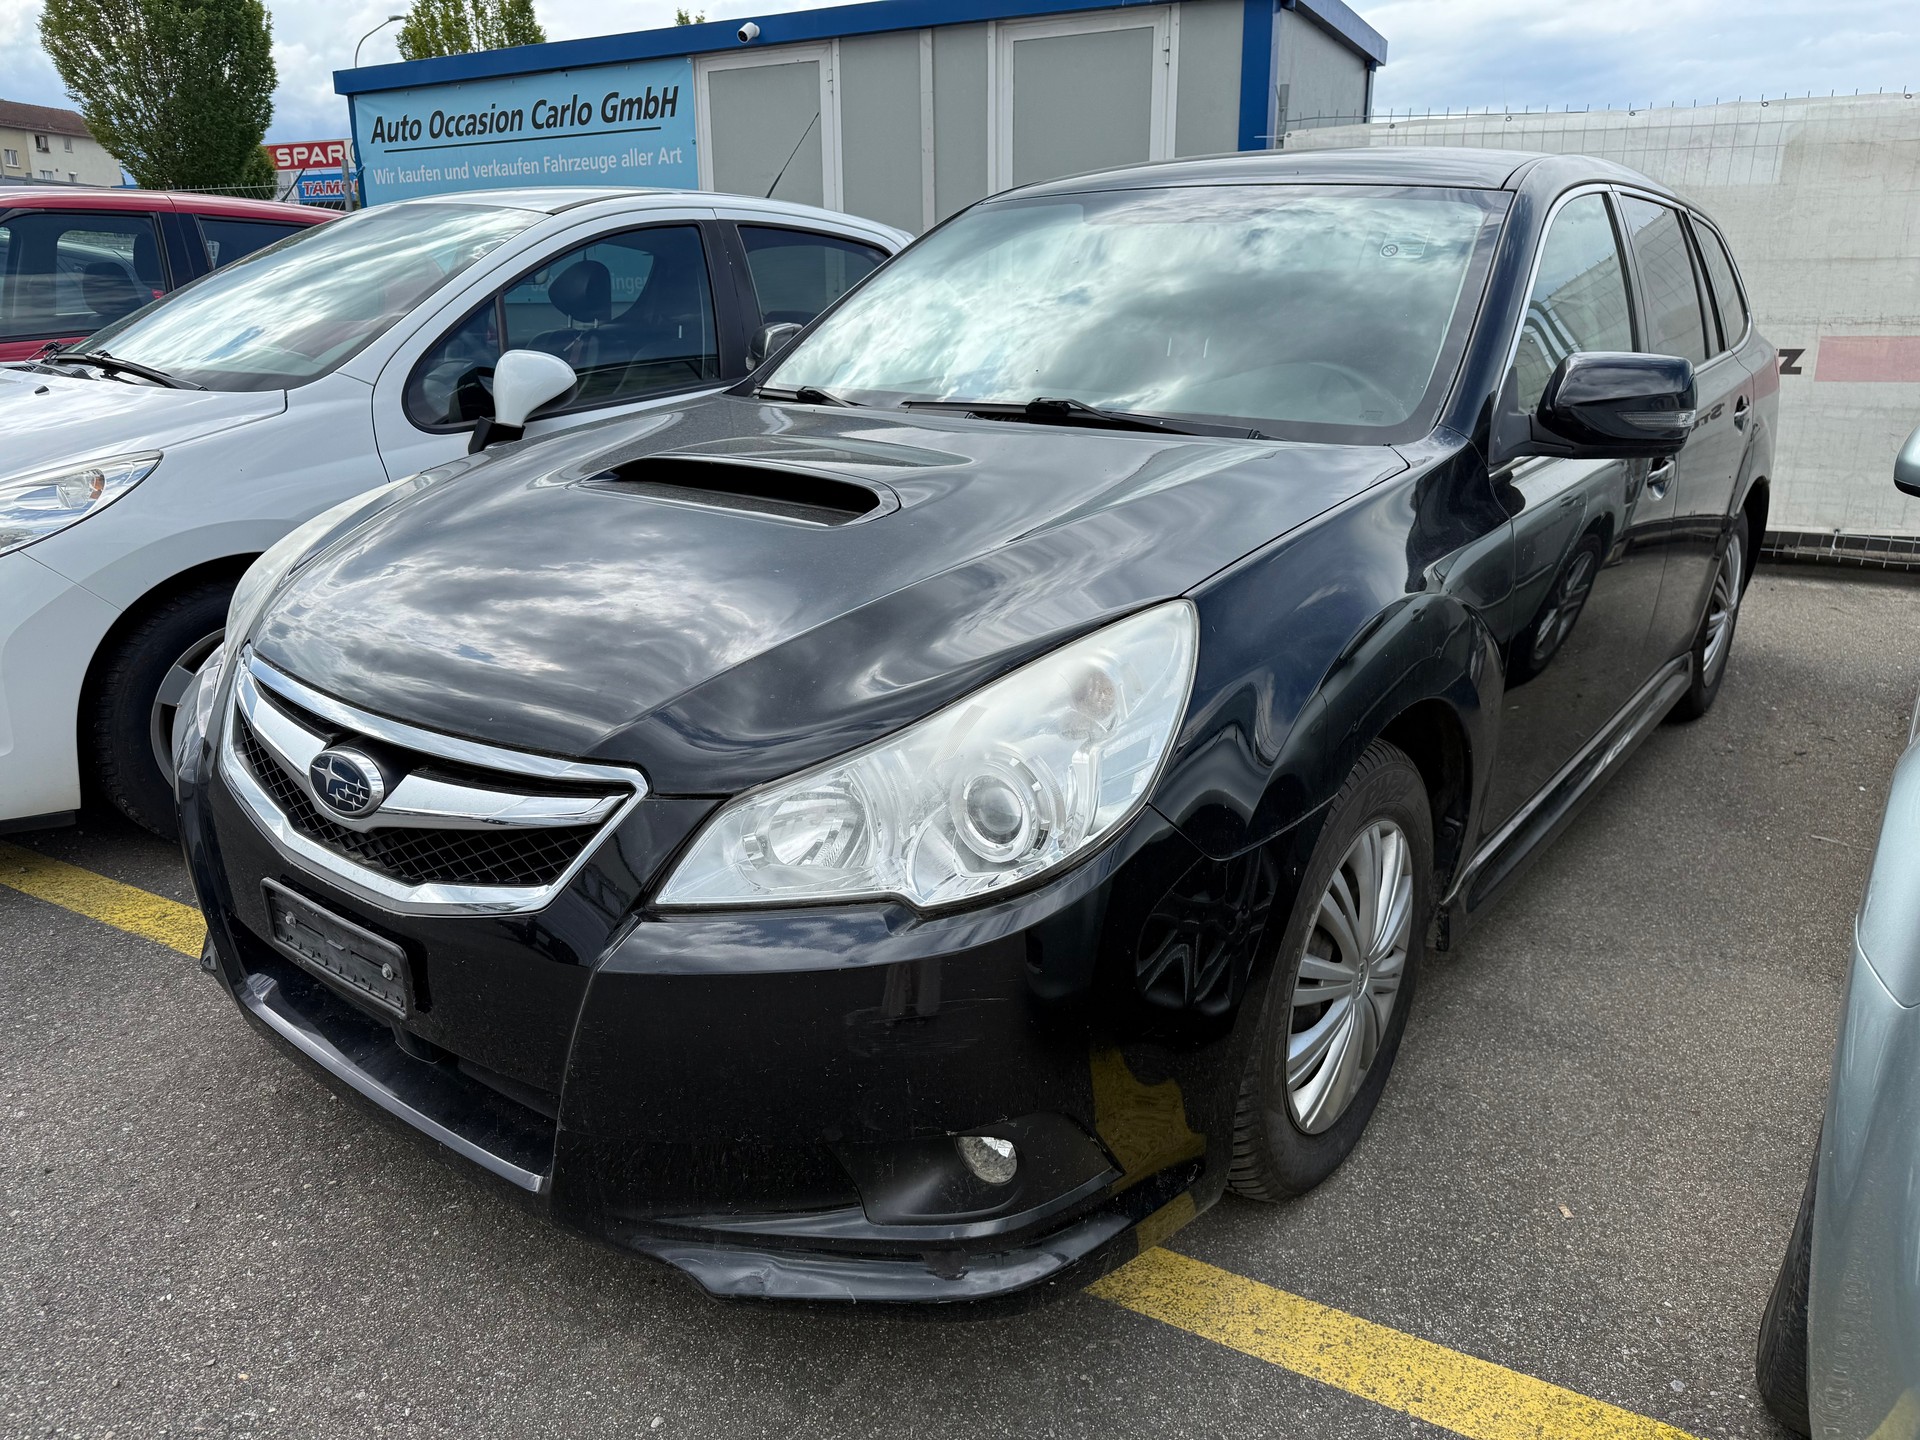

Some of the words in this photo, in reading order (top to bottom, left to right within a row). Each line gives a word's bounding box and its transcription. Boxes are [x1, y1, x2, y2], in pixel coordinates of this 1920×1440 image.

[371, 114, 422, 144] Auto
[429, 103, 523, 139] Occasion
[531, 94, 593, 130] Carlo
[601, 85, 679, 123] GmbH
[276, 144, 344, 167] SPAR
[373, 167, 395, 185] Wir
[397, 165, 441, 184] kaufen
[445, 162, 470, 179] und
[472, 157, 540, 178] verkaufen
[543, 153, 618, 174] Fahrzeuge
[621, 148, 654, 168] aller
[658, 146, 682, 165] Art
